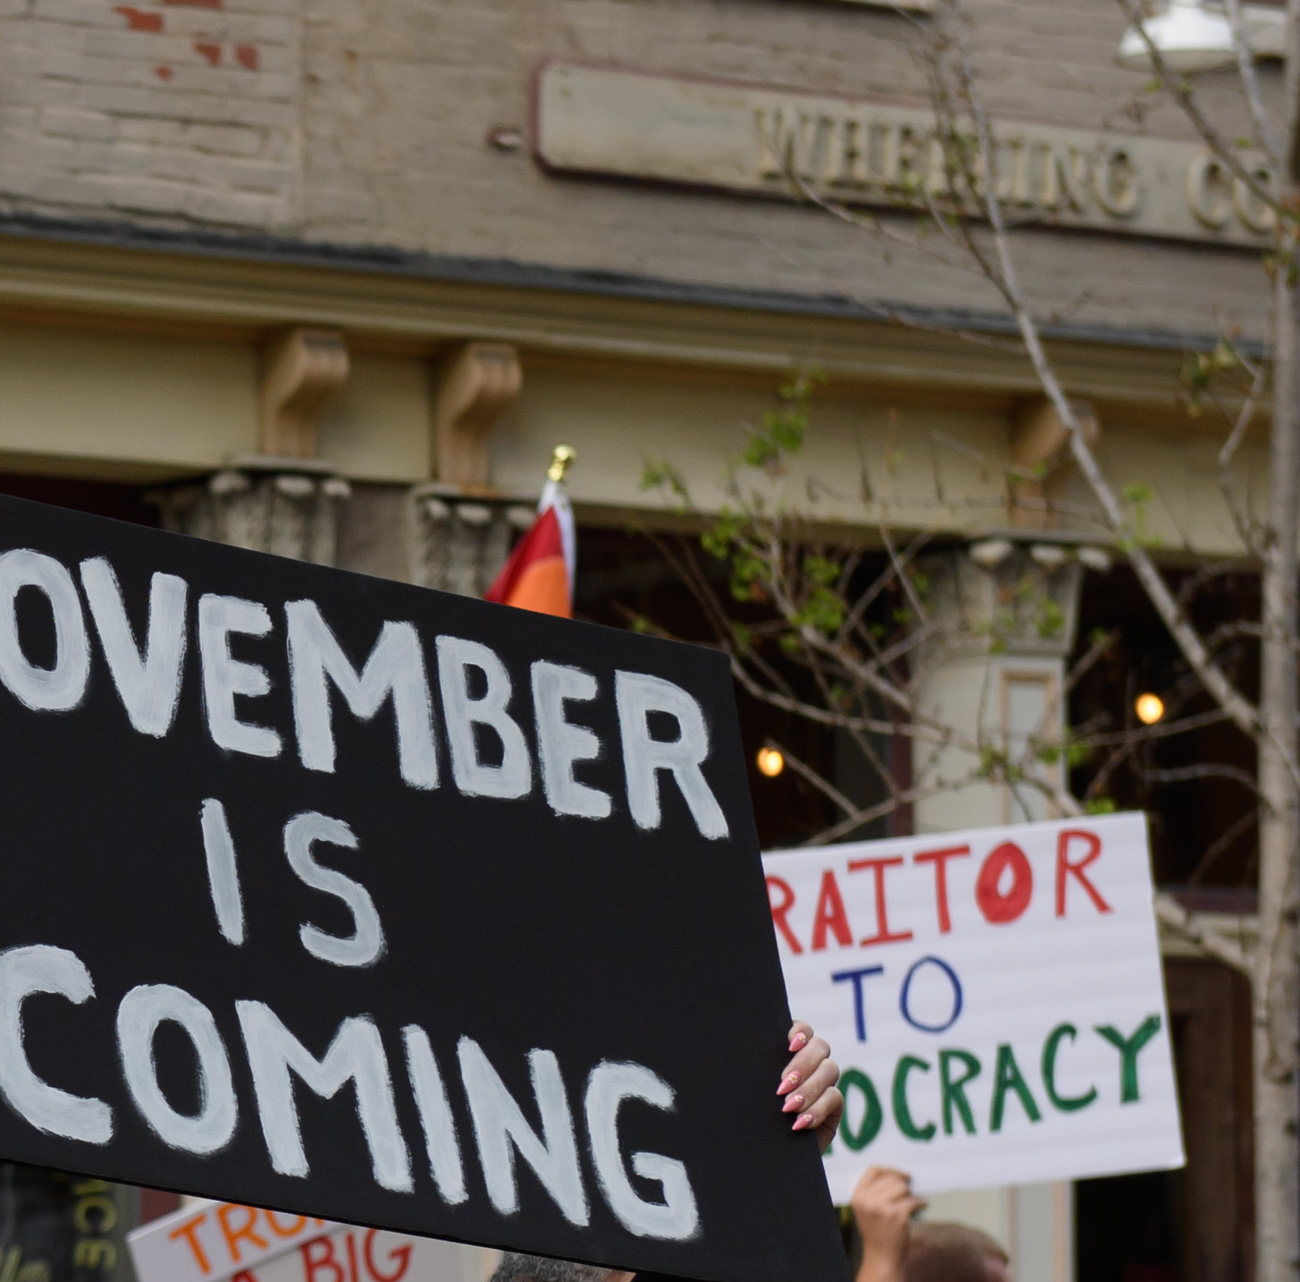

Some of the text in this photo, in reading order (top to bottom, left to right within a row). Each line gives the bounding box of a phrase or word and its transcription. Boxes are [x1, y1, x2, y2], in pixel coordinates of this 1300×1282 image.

[201, 797, 386, 968] IS
[766, 828, 1114, 956] RAITOR
[832, 956, 963, 1043] TO
[822, 1013, 1163, 1156] OCRACY
[169, 1202, 326, 1276] TRU
